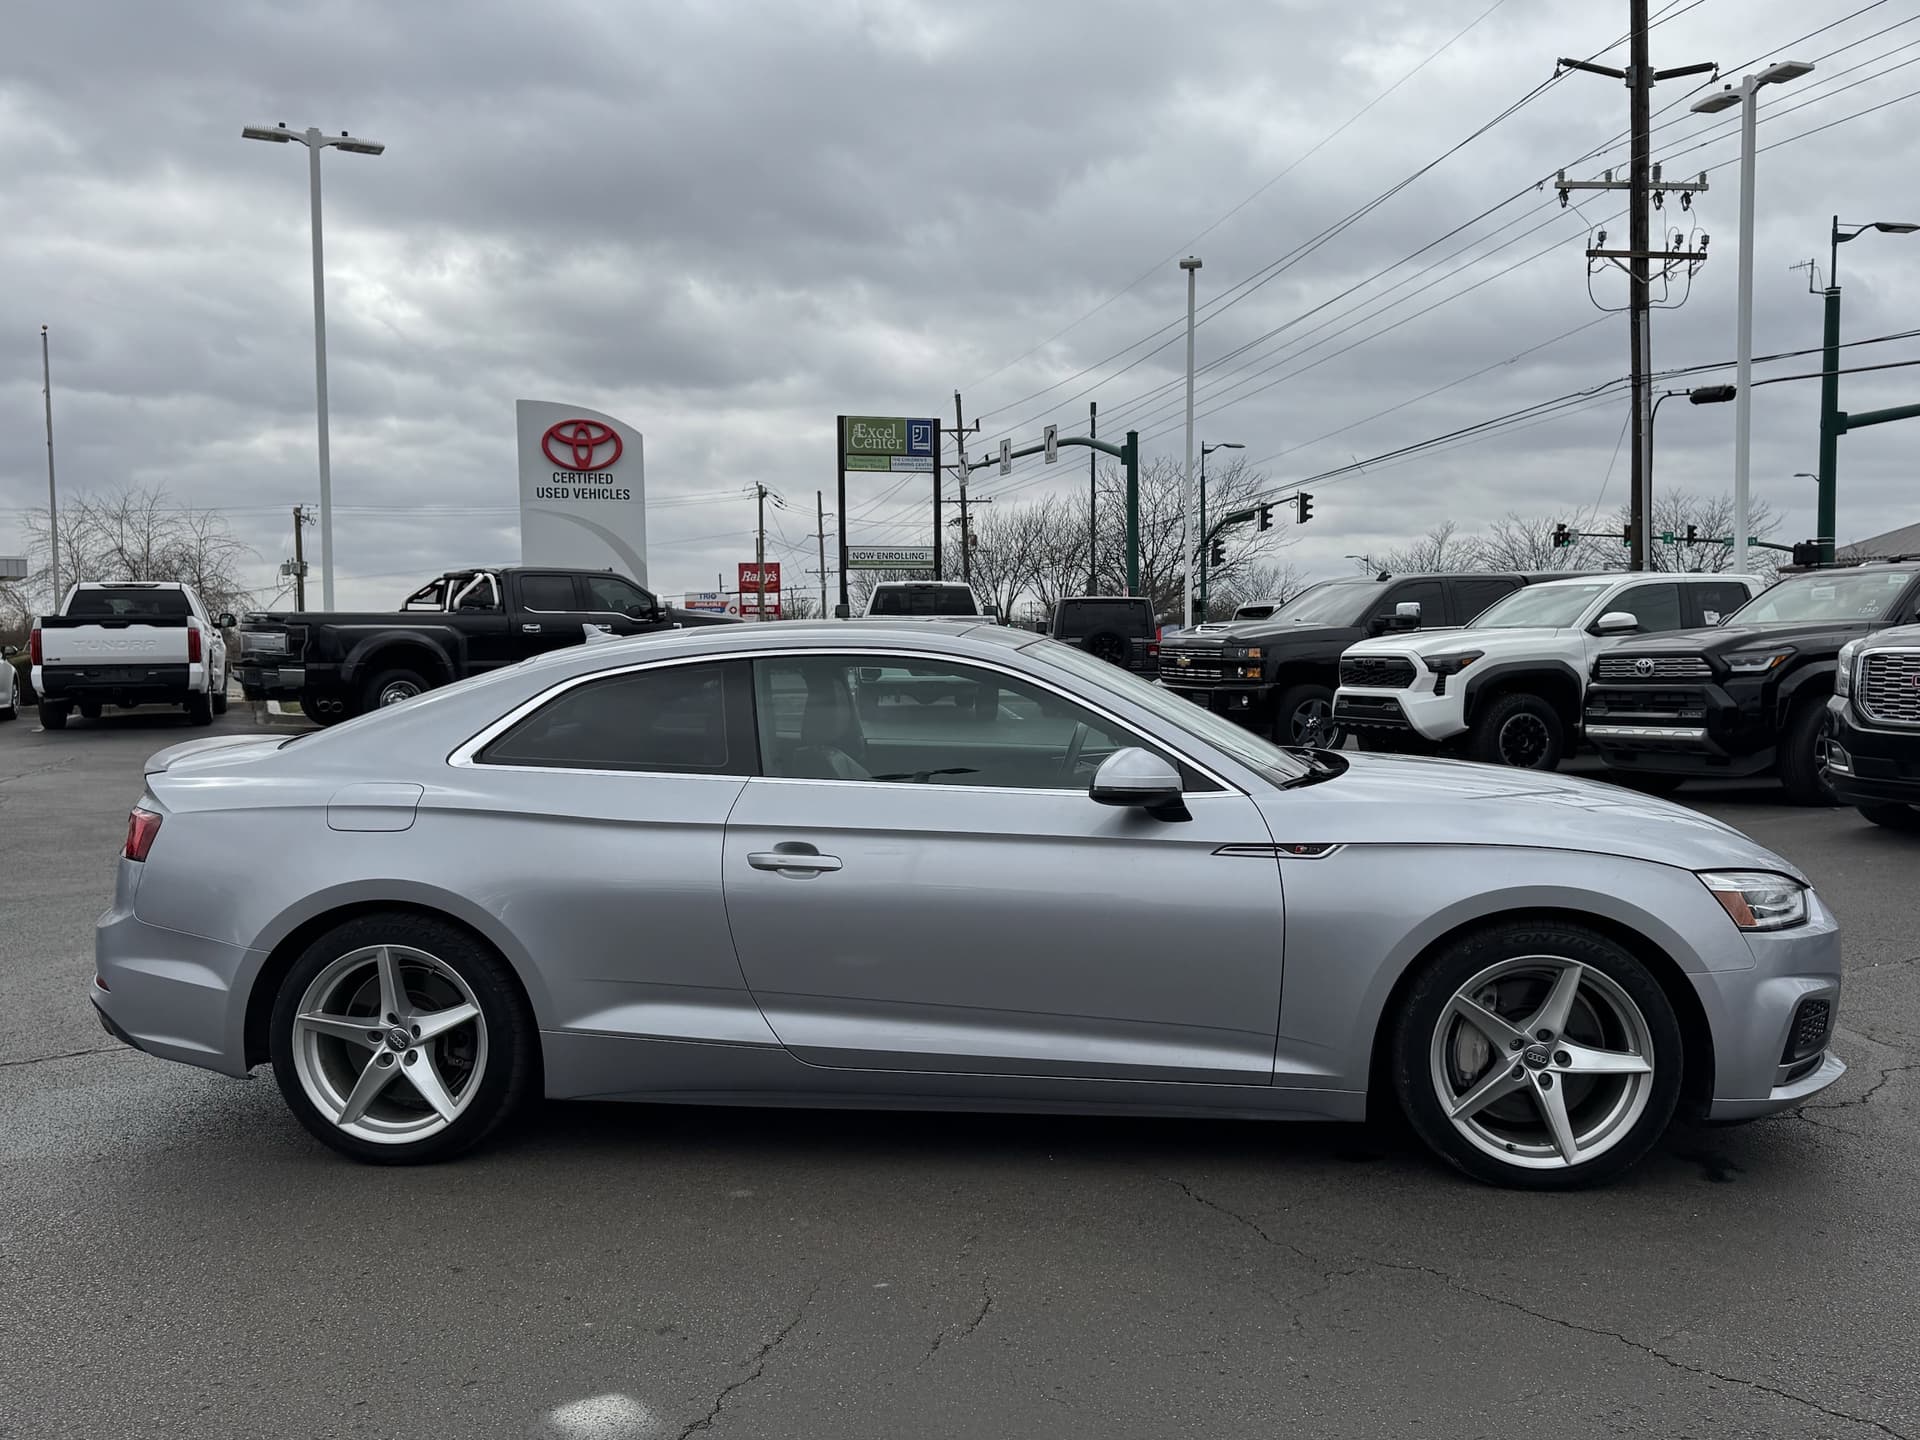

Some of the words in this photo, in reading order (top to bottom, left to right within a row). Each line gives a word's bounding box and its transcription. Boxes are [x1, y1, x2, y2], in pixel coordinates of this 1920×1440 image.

[857, 423, 896, 439] Excel
[851, 435, 903, 449] Center
[552, 471, 614, 485] CERTIFIED
[536, 487, 569, 499] USED
[573, 487, 631, 500] VEHICLES
[877, 552, 927, 560] ENROLLING!
[741, 570, 777, 584] Raly's
[72, 639, 159, 651] TUNDRA
